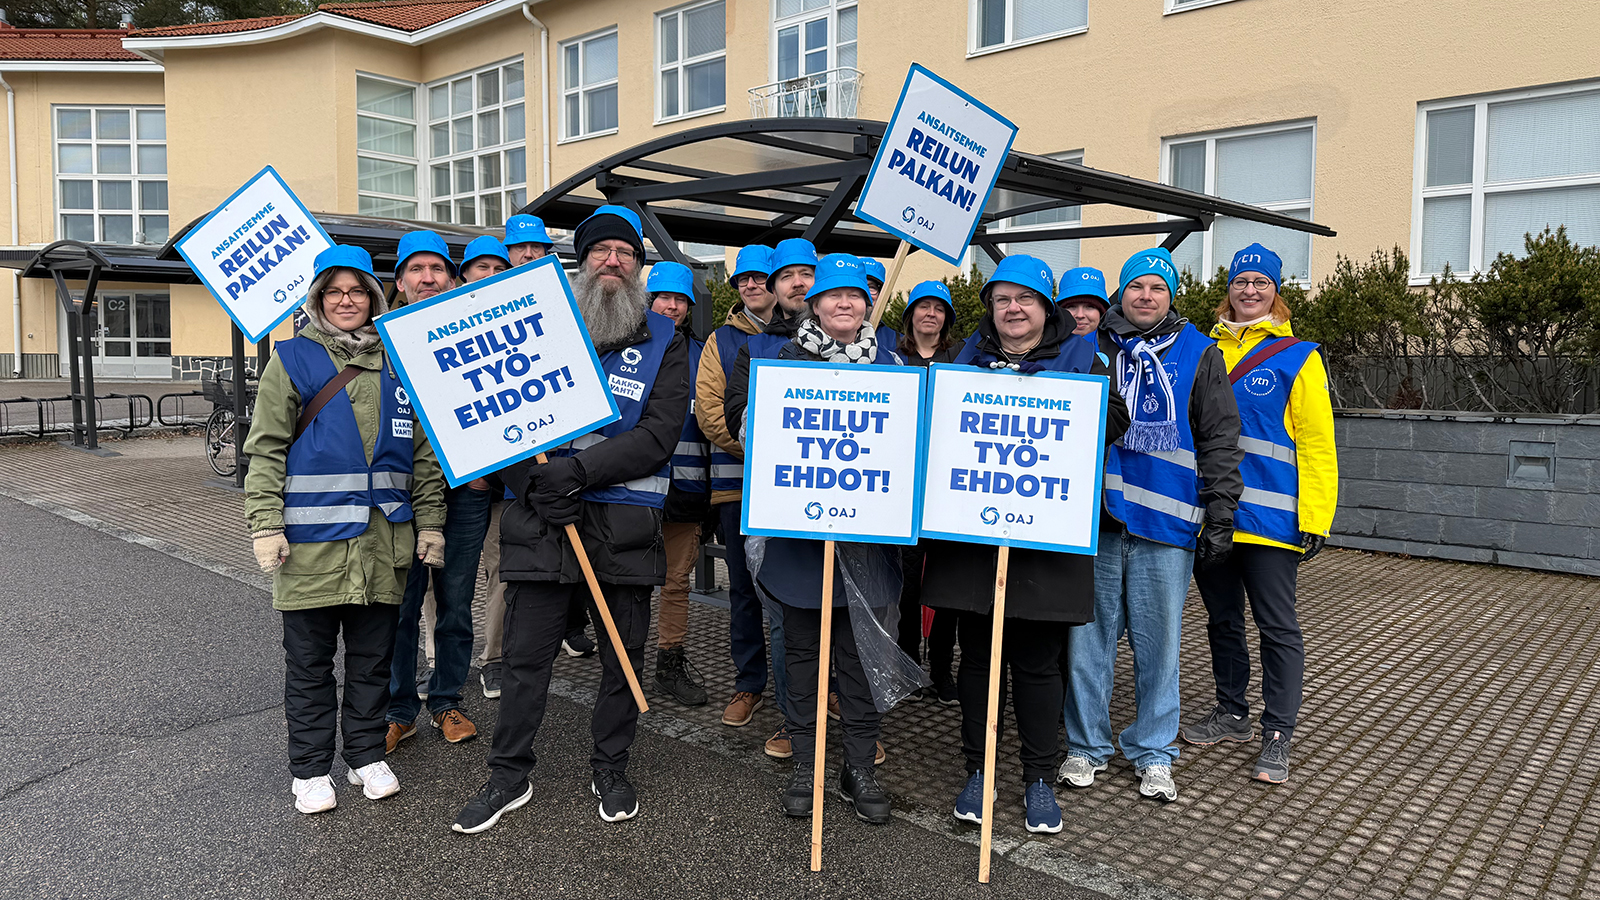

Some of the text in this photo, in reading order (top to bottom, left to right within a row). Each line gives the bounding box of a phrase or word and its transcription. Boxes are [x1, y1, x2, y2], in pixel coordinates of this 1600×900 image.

[917, 111, 987, 158] ANSAITSEMME
[906, 127, 980, 184] REILUN
[888, 148, 977, 212] PALKAN!
[212, 202, 275, 260] ANSAITSEMME
[917, 216, 934, 230] OAJ
[219, 214, 290, 278] REILUN
[226, 225, 310, 300] PALKAN!
[1146, 256, 1174, 277] ytn
[1233, 254, 1261, 272] ytn
[287, 275, 304, 291] OAJ
[108, 299, 125, 311] C2
[428, 294, 537, 343] ANSAITSEMME
[433, 312, 544, 372] REILUT
[462, 347, 541, 392] TYÖ-
[620, 365, 638, 374] OAJ
[1251, 376, 1269, 387] ytn
[610, 384, 635, 396] VAHTI
[611, 377, 642, 390] LAKKO-
[784, 388, 890, 403] ANSAITSEMME
[397, 407, 411, 415] OAJ
[454, 366, 574, 430] EHDOT!
[962, 392, 1071, 411] ANSAITSEMME
[527, 414, 554, 431] OAJ
[783, 407, 889, 434] REILUT
[960, 411, 1070, 441] REILUT
[797, 433, 870, 461] TYÖ-
[974, 439, 1049, 467] TYÖ-
[774, 465, 890, 493] EHDOT!
[950, 468, 1069, 501] EHDOT!
[829, 507, 856, 518] OAJ
[1006, 513, 1033, 524] OAJ
